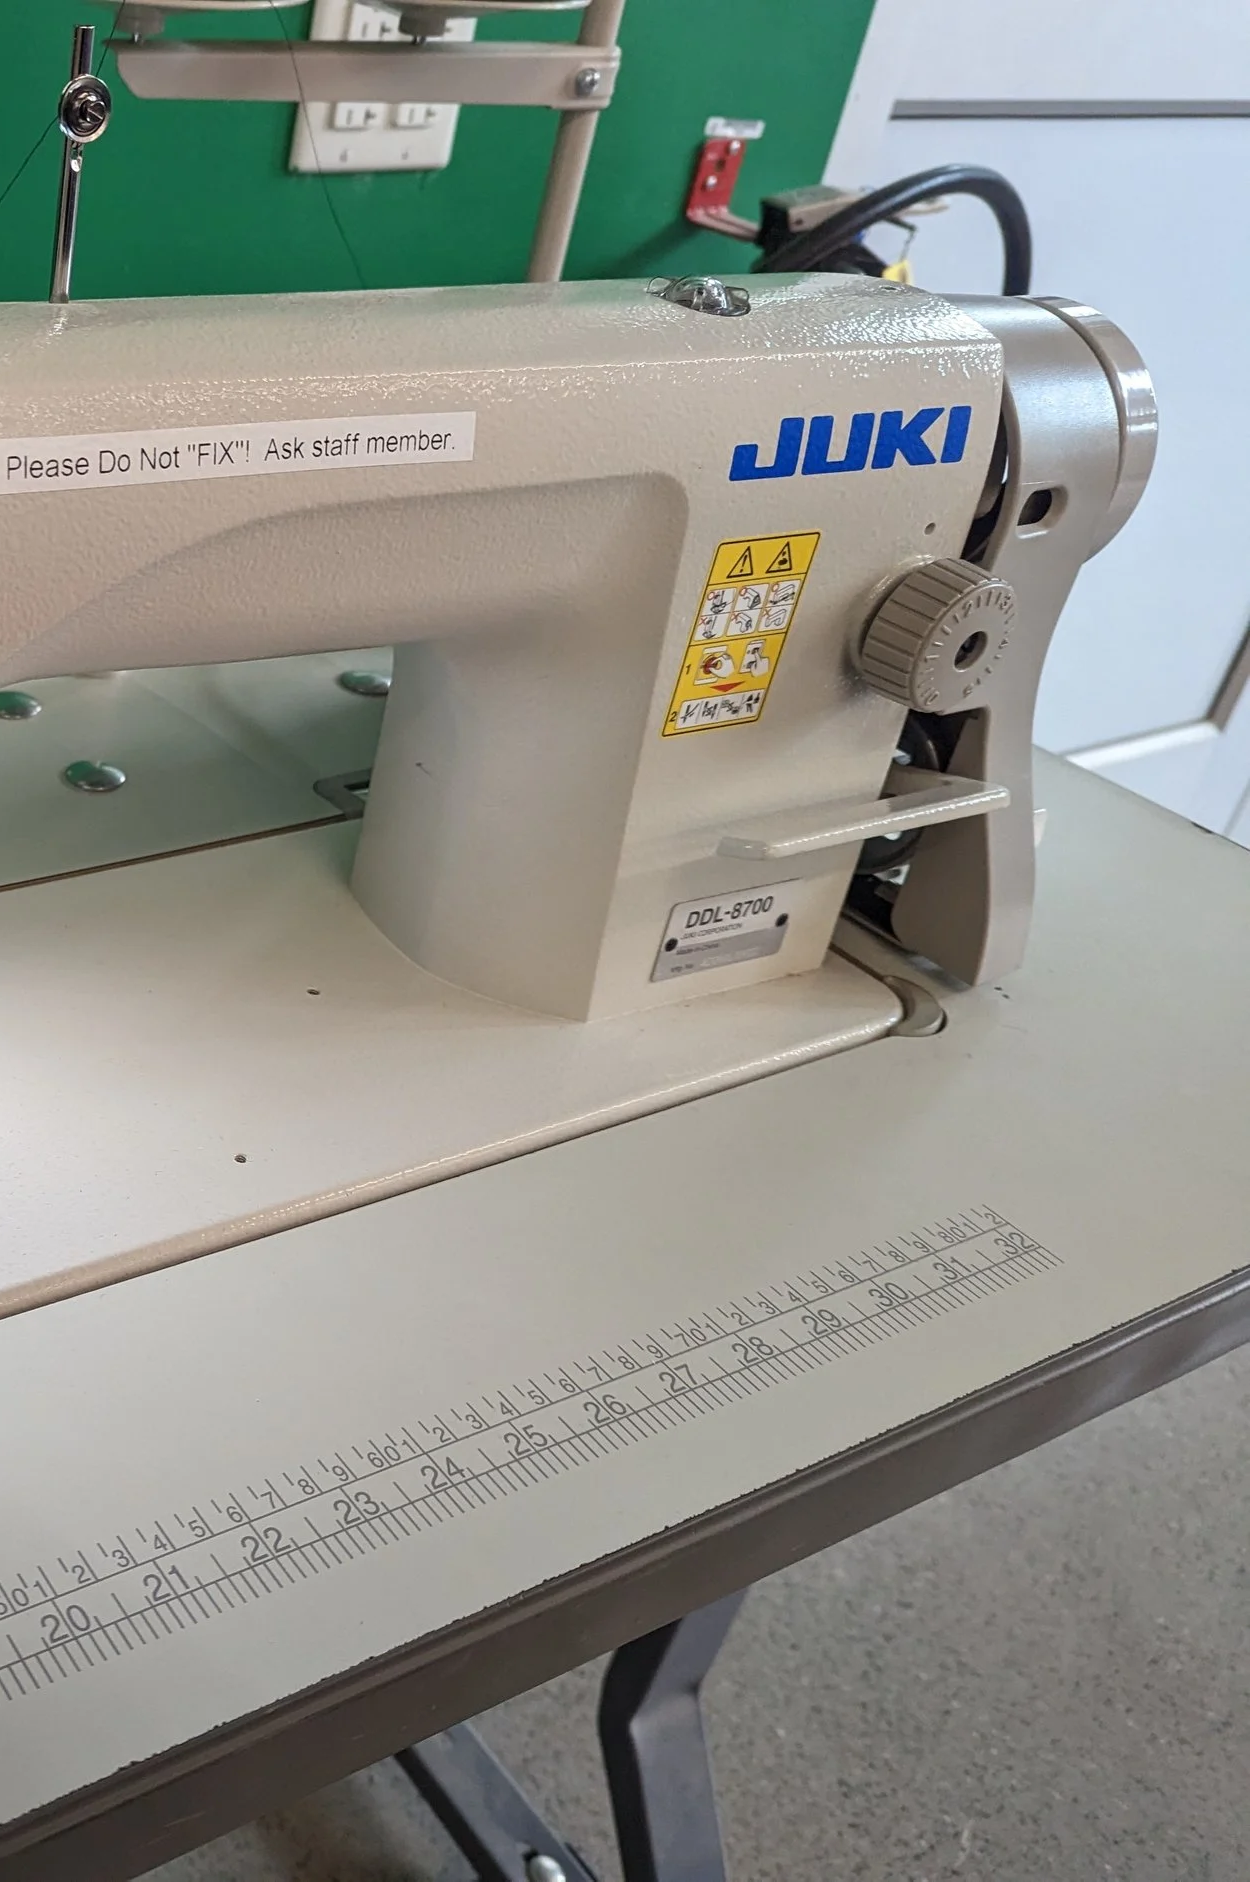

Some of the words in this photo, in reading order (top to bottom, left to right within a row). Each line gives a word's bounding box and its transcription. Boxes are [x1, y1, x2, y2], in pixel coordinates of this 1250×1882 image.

[6, 453, 89, 481] Please
[99, 449, 131, 475] Do
[139, 446, 180, 471] Not
[187, 440, 251, 467] "FIX"!
[264, 437, 304, 463] Ask
[312, 431, 359, 457] staff
[366, 430, 456, 455] member.
[729, 406, 971, 481] JUKI
[668, 711, 678, 723] 2
[684, 896, 774, 929] DDL-8700
[32, 1580, 48, 1598] 1
[71, 1565, 91, 1584] 2
[112, 1549, 130, 1568] 3
[153, 1534, 168, 1552] 4
[188, 1519, 206, 1538] 5
[226, 1506, 243, 1523] 6
[260, 1491, 276, 1509] 7
[297, 1478, 315, 1496] 8
[332, 1465, 349, 1482] 9
[402, 1439, 416, 1454] 1
[432, 1427, 451, 1443] 2
[465, 1414, 483, 1430] 3
[500, 1401, 514, 1416] 4
[527, 1389, 545, 1406] 5
[558, 1378, 576, 1393] 6
[587, 1366, 603, 1381] 7
[617, 1355, 635, 1370] 8
[646, 1344, 663, 1359] 9
[705, 1322, 720, 1335] 1
[731, 1312, 749, 1326] 2
[758, 1301, 776, 1315] 3
[787, 1290, 803, 1303] 4
[811, 1280, 829, 1294] 5
[838, 1270, 855, 1283] 6
[862, 1260, 878, 1273] 7
[888, 1250, 906, 1263] 8
[912, 1240, 930, 1254] 9
[962, 1221, 978, 1233] 1
[984, 1212, 1003, 1225] 2
[40, 1605, 91, 1643] 20
[143, 1565, 190, 1601] 21
[240, 1526, 291, 1562] 22
[333, 1491, 380, 1525] 23
[420, 1457, 466, 1490] 24
[503, 1425, 548, 1456] 25
[583, 1394, 627, 1424] 26
[659, 1363, 697, 1393] 27
[732, 1336, 774, 1364] 28
[801, 1309, 842, 1336] 29
[868, 1282, 909, 1308] 30
[933, 1256, 972, 1281] 31
[994, 1232, 1035, 1255] 32
